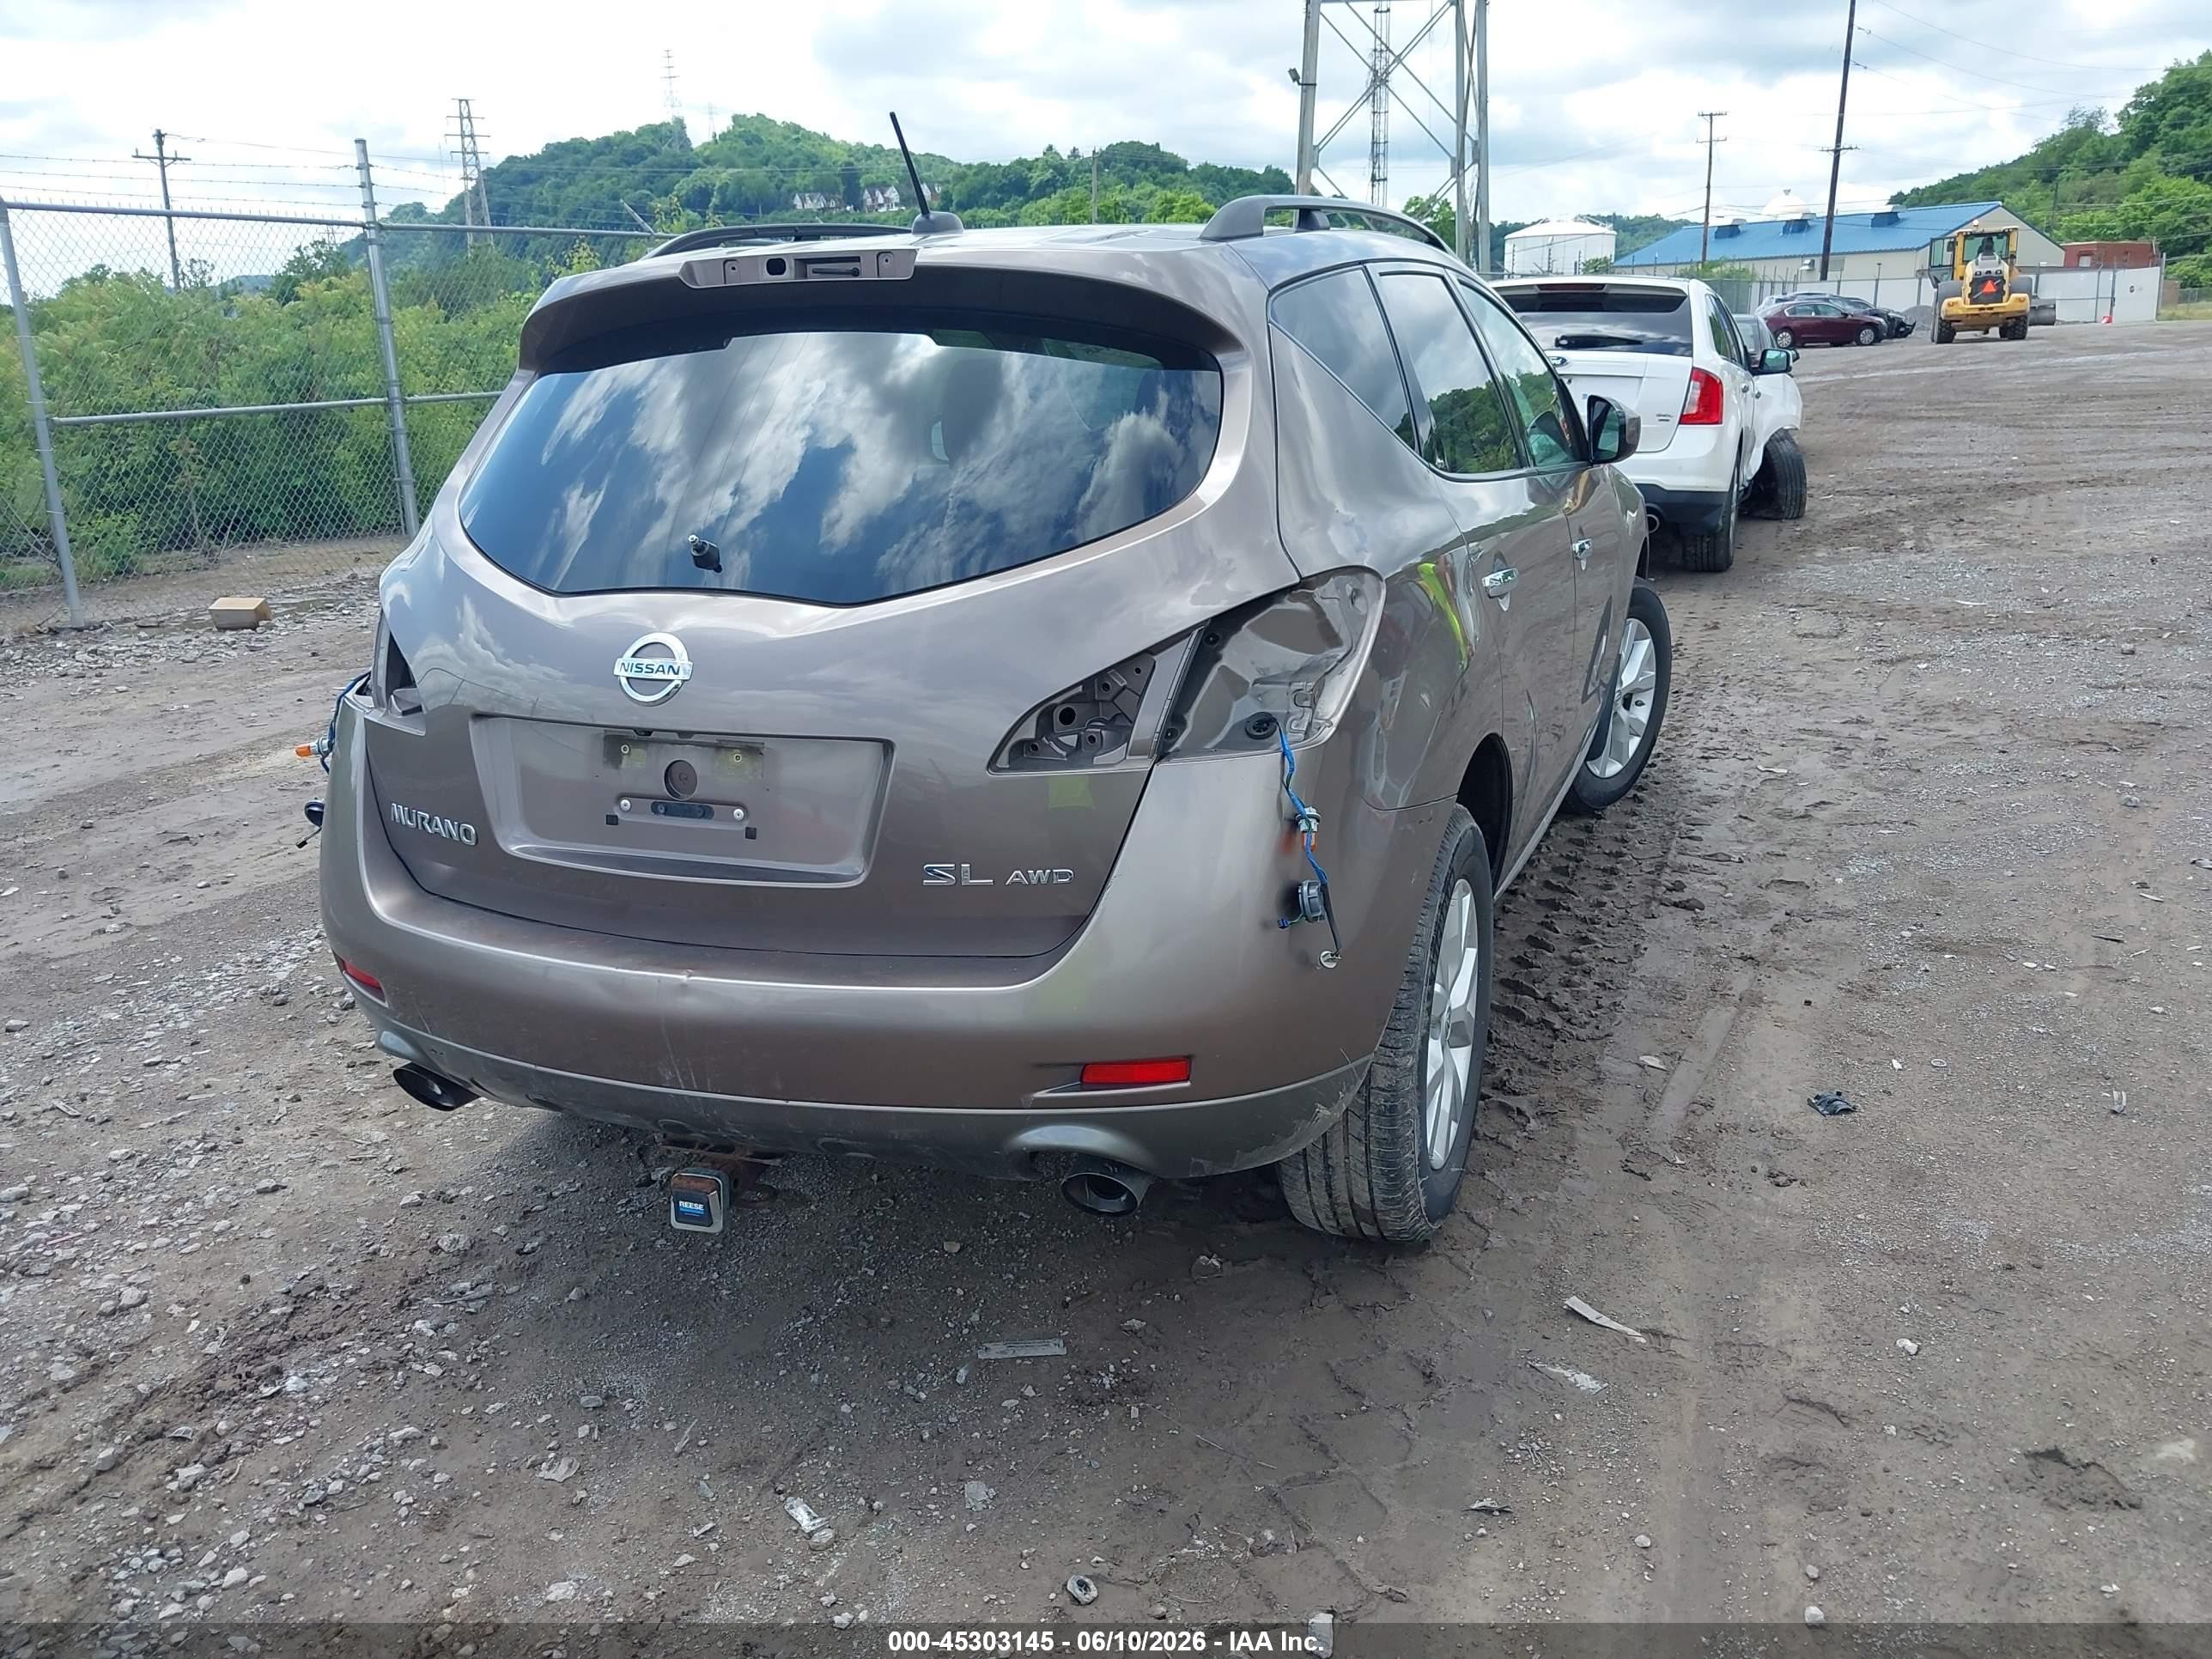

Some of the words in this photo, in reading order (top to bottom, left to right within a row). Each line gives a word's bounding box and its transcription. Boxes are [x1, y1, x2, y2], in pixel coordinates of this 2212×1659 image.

[619, 661, 681, 676] NISSAN
[391, 803, 477, 846] MURANO
[922, 863, 994, 886] SL
[1005, 869, 1074, 886] AWD
[678, 1200, 705, 1211] REESE
